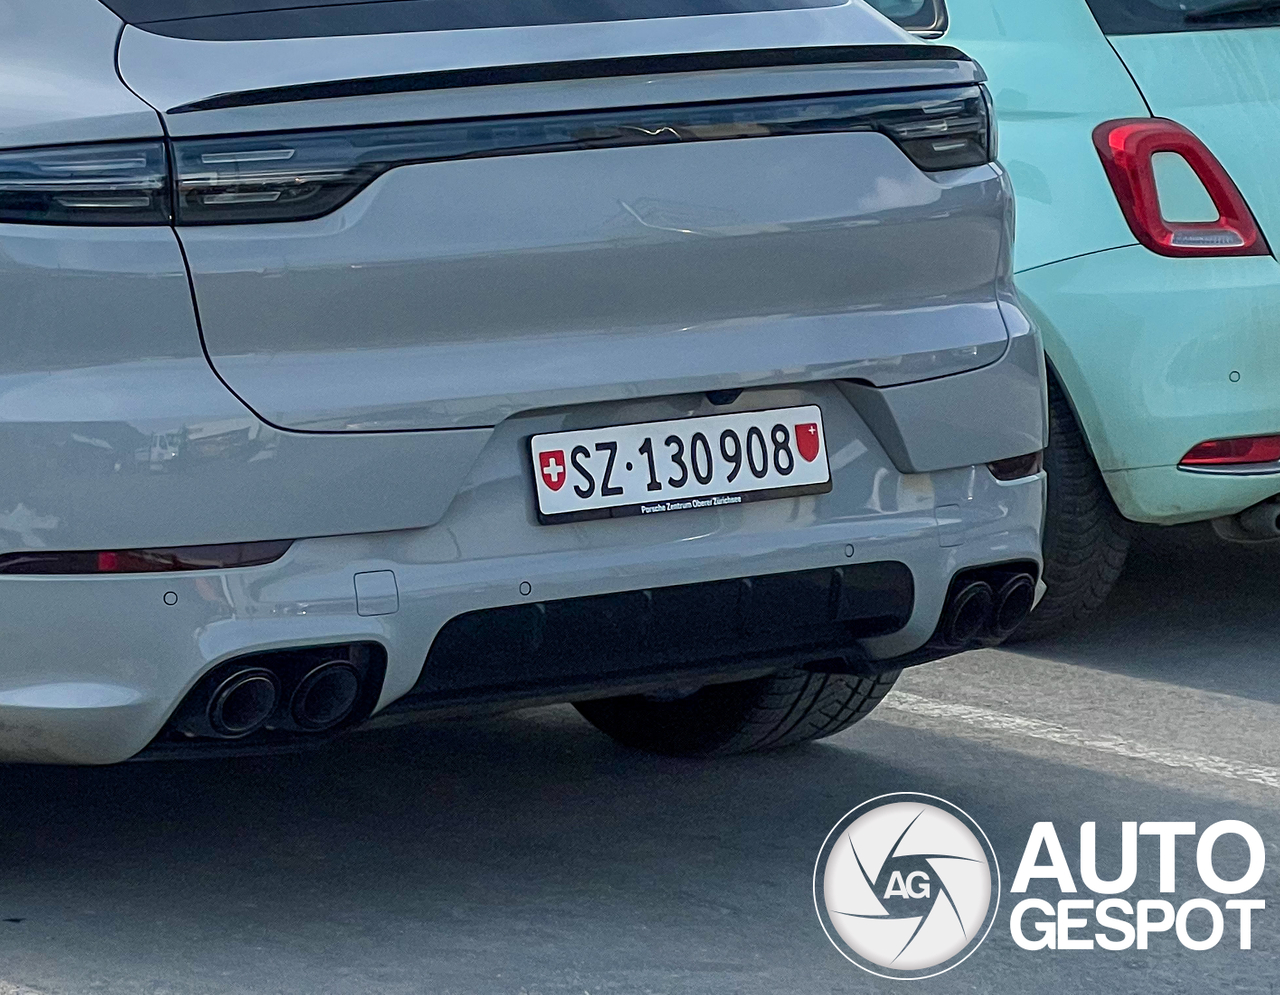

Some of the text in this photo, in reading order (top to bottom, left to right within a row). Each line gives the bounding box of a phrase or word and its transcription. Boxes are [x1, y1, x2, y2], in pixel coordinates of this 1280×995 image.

[640, 504, 666, 514] Porsche
[666, 501, 692, 511] Zentrum
[692, 498, 713, 508] Oberer
